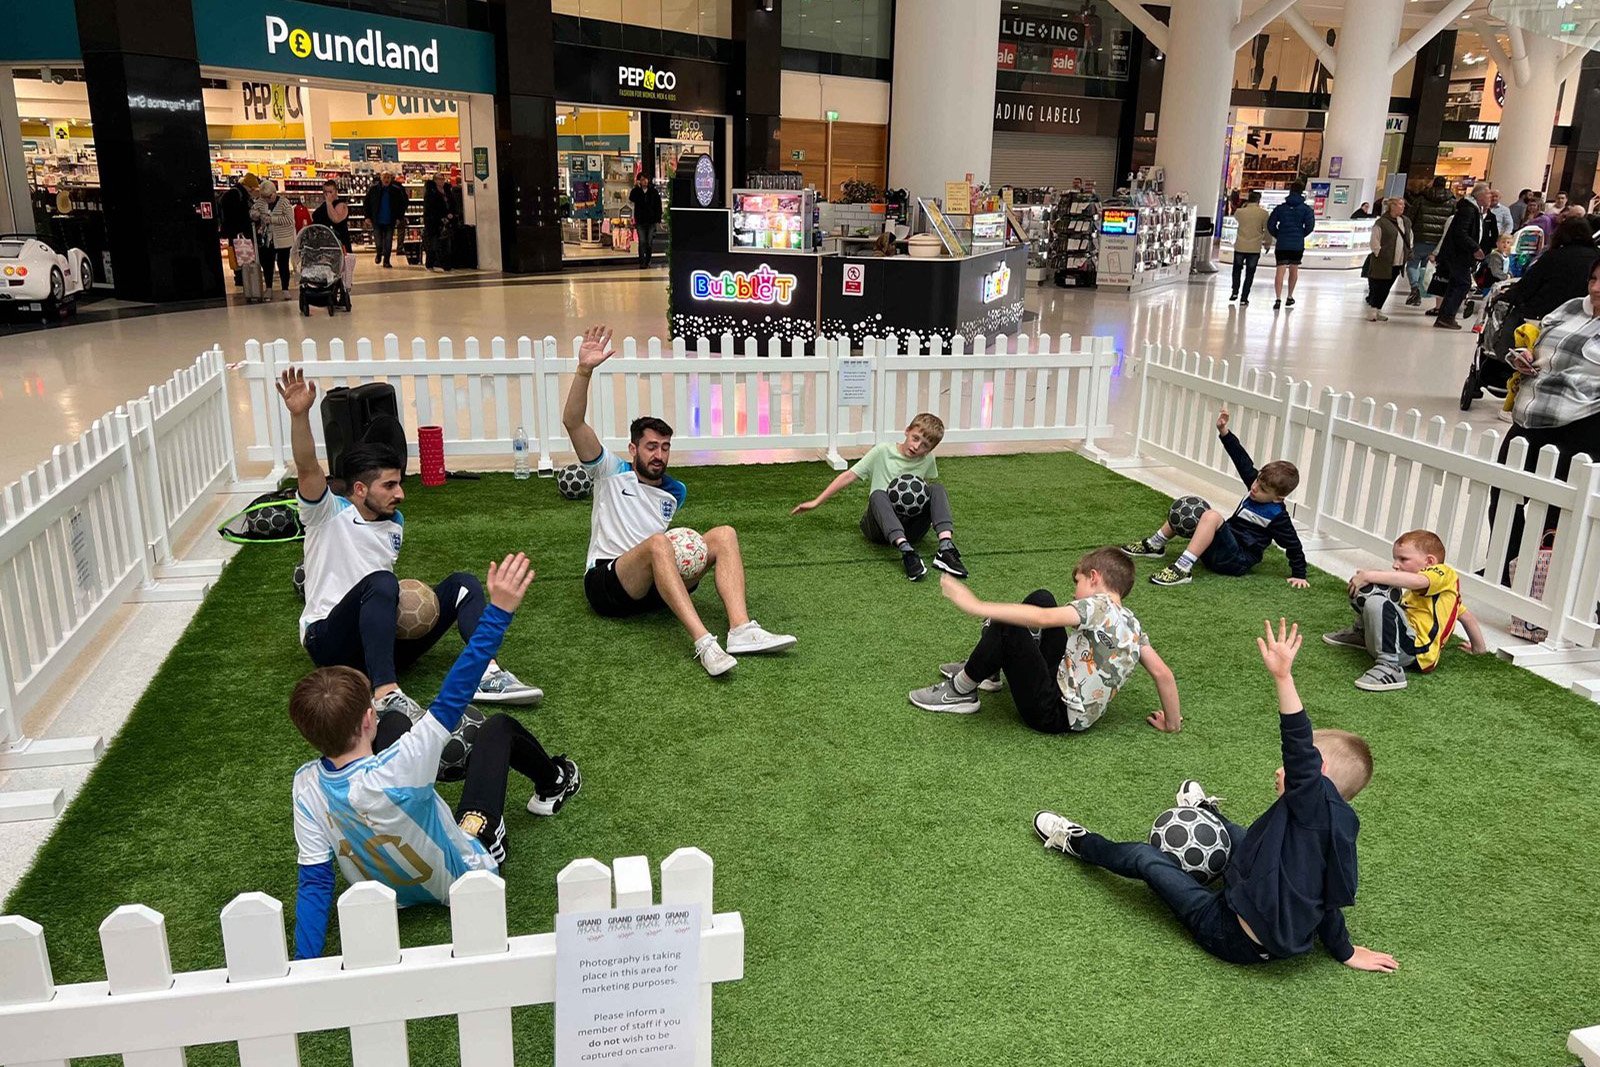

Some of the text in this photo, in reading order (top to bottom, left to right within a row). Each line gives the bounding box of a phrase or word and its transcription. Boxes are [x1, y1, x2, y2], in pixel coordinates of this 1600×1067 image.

[1002, 19, 1036, 37] LUE
[997, 48, 1014, 64] ale
[1052, 54, 1074, 70] sale
[995, 103, 1081, 124] ADING LABELS
[1468, 124, 1500, 140] THE HM
[577, 918, 602, 927] GRAND
[607, 915, 632, 925] GRAND
[635, 913, 661, 922] GRAND
[665, 911, 690, 919] GRAND
[579, 951, 681, 968] Photography is taking
[582, 964, 678, 982] place in this area for
[581, 978, 677, 994] marketing purposes.
[593, 1012, 624, 1021] Please
[626, 1008, 657, 1018] inform
[577, 1019, 681, 1036] member of staff if you
[588, 1031, 670, 1048] do not wish to be
[581, 1049, 623, 1061] captured
[639, 1043, 677, 1054] camera.
